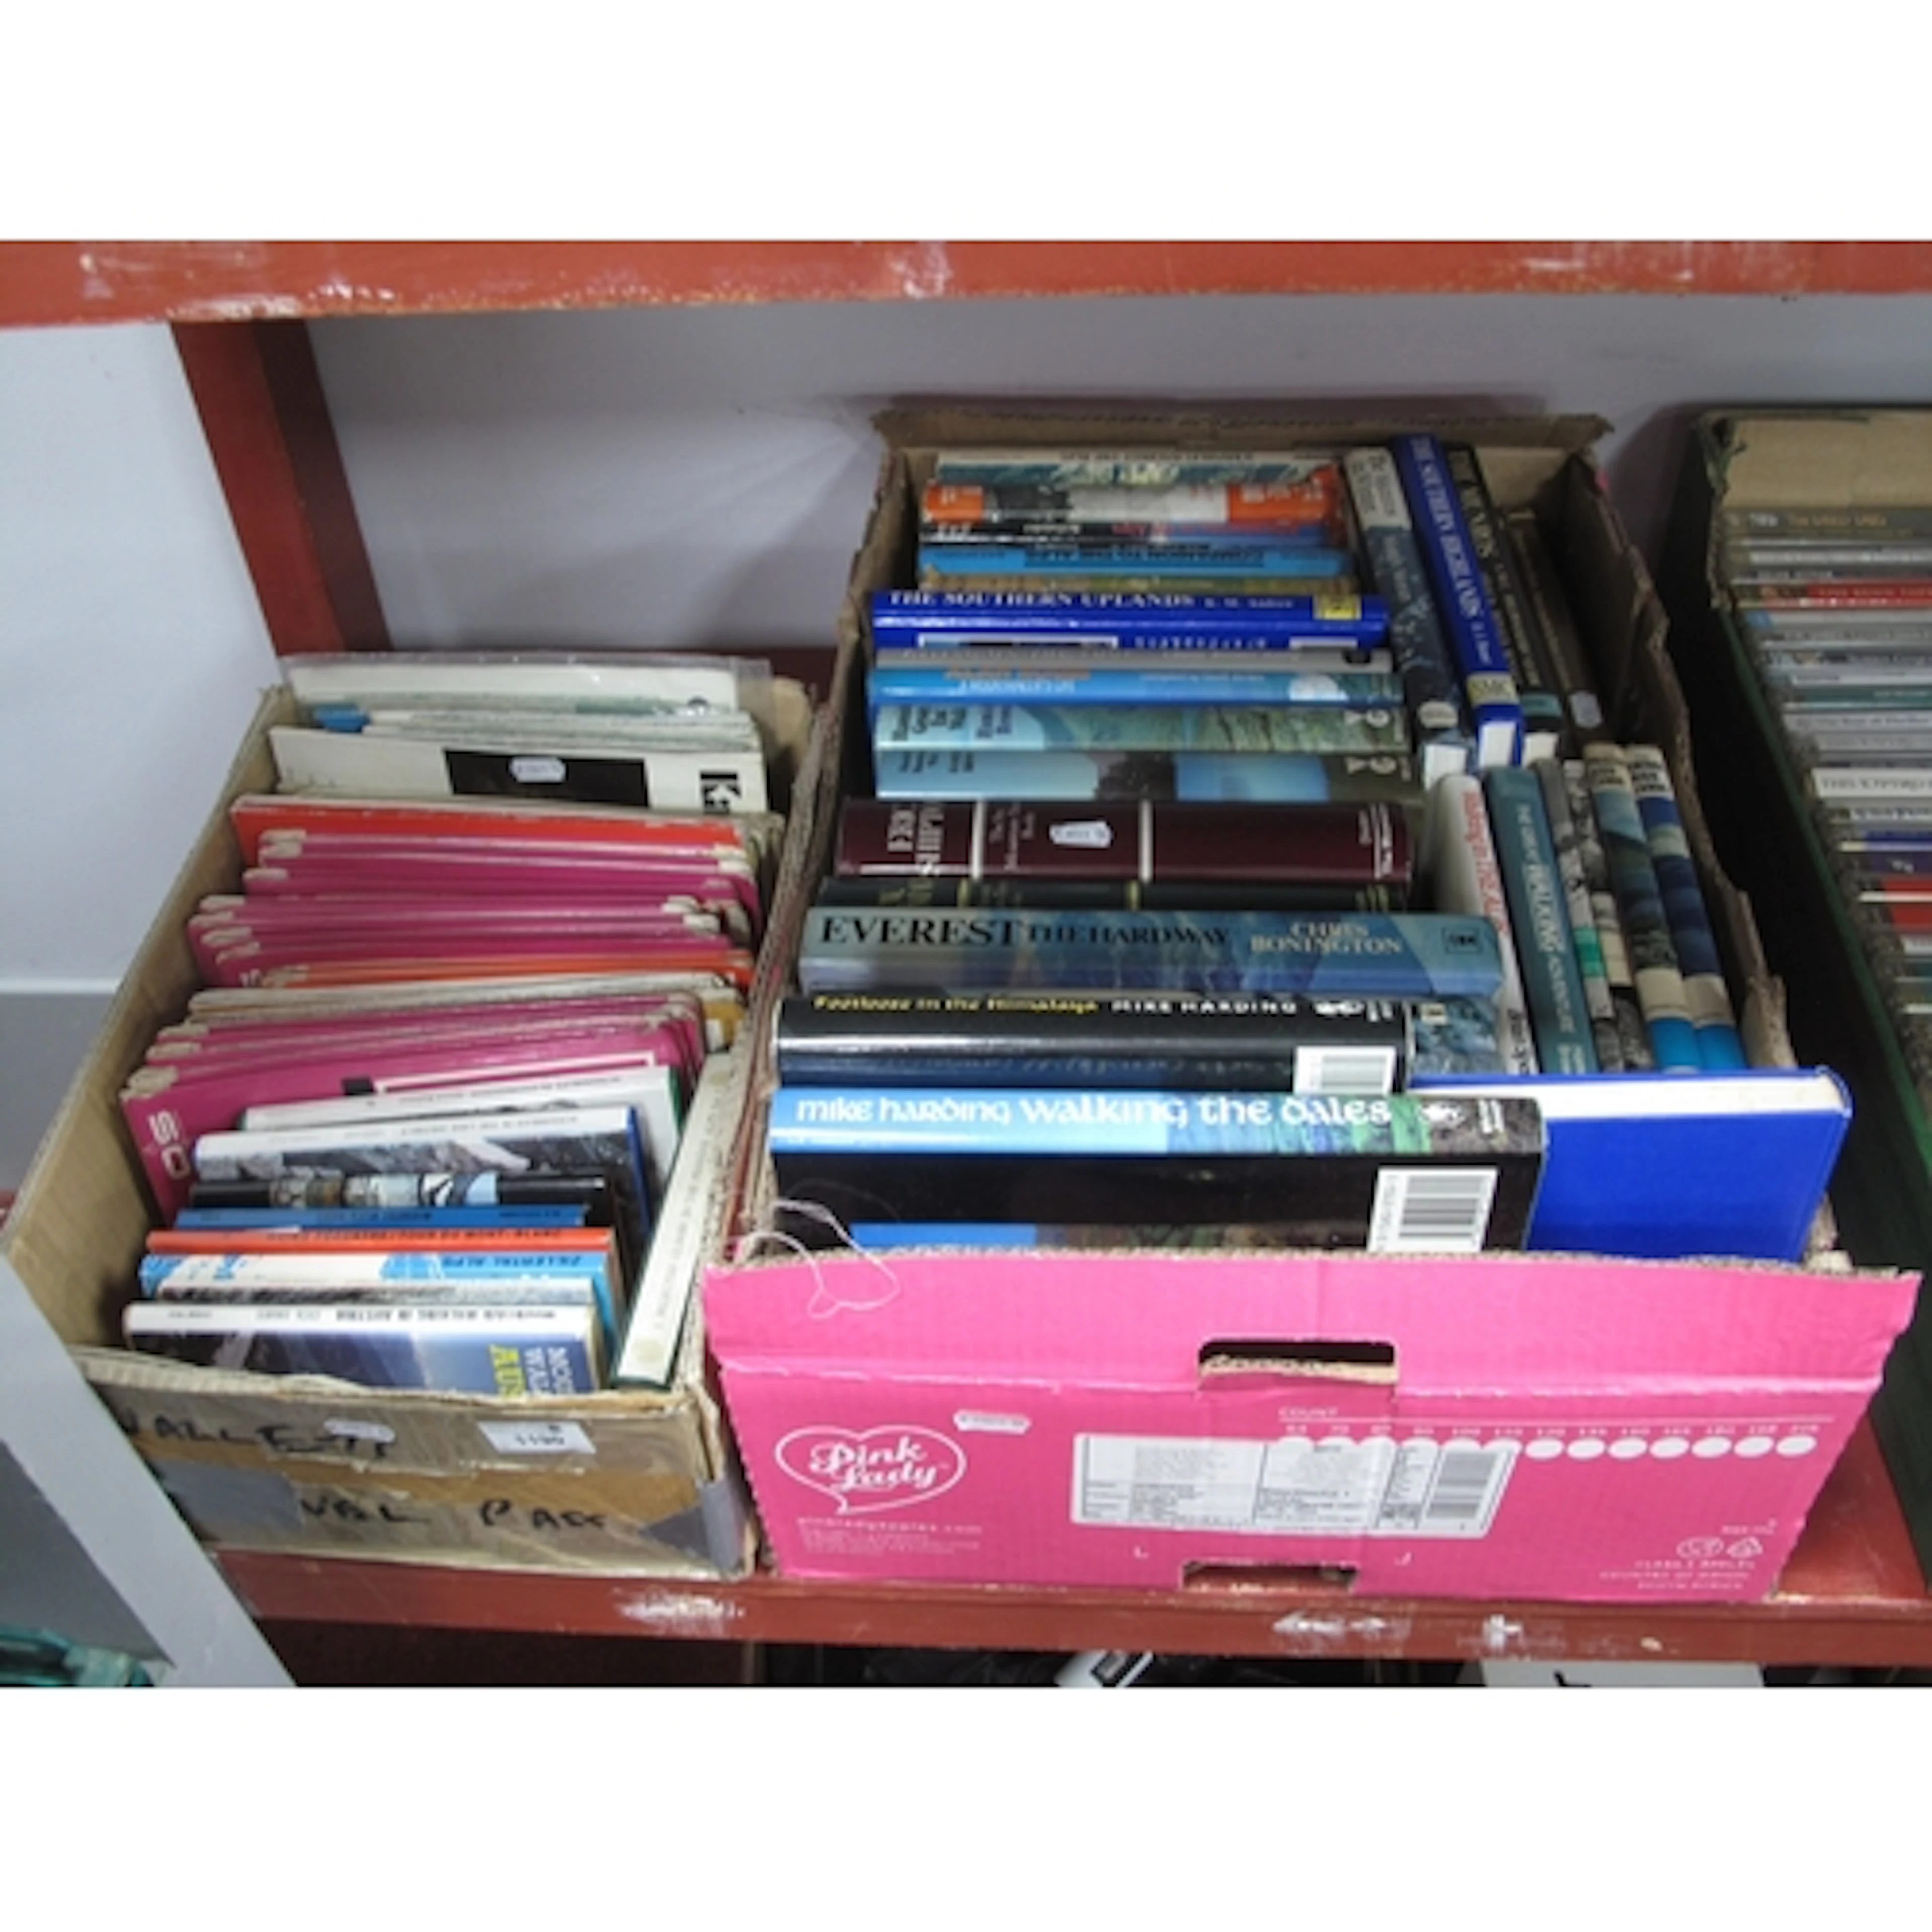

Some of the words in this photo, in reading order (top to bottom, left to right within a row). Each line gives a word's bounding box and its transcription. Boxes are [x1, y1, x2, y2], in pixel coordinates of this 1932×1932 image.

[1081, 593, 1195, 607] UPLANDS
[821, 915, 1022, 946] EVEREST
[1025, 920, 1085, 946] THE
[1289, 922, 1370, 938] CHRIS
[1250, 934, 1403, 955] BONINGTON
[1110, 1000, 1171, 1015] MIKE
[1180, 1000, 1298, 1015] HARDING
[810, 1435, 927, 1474] Pink
[830, 1461, 937, 1492] Lady
